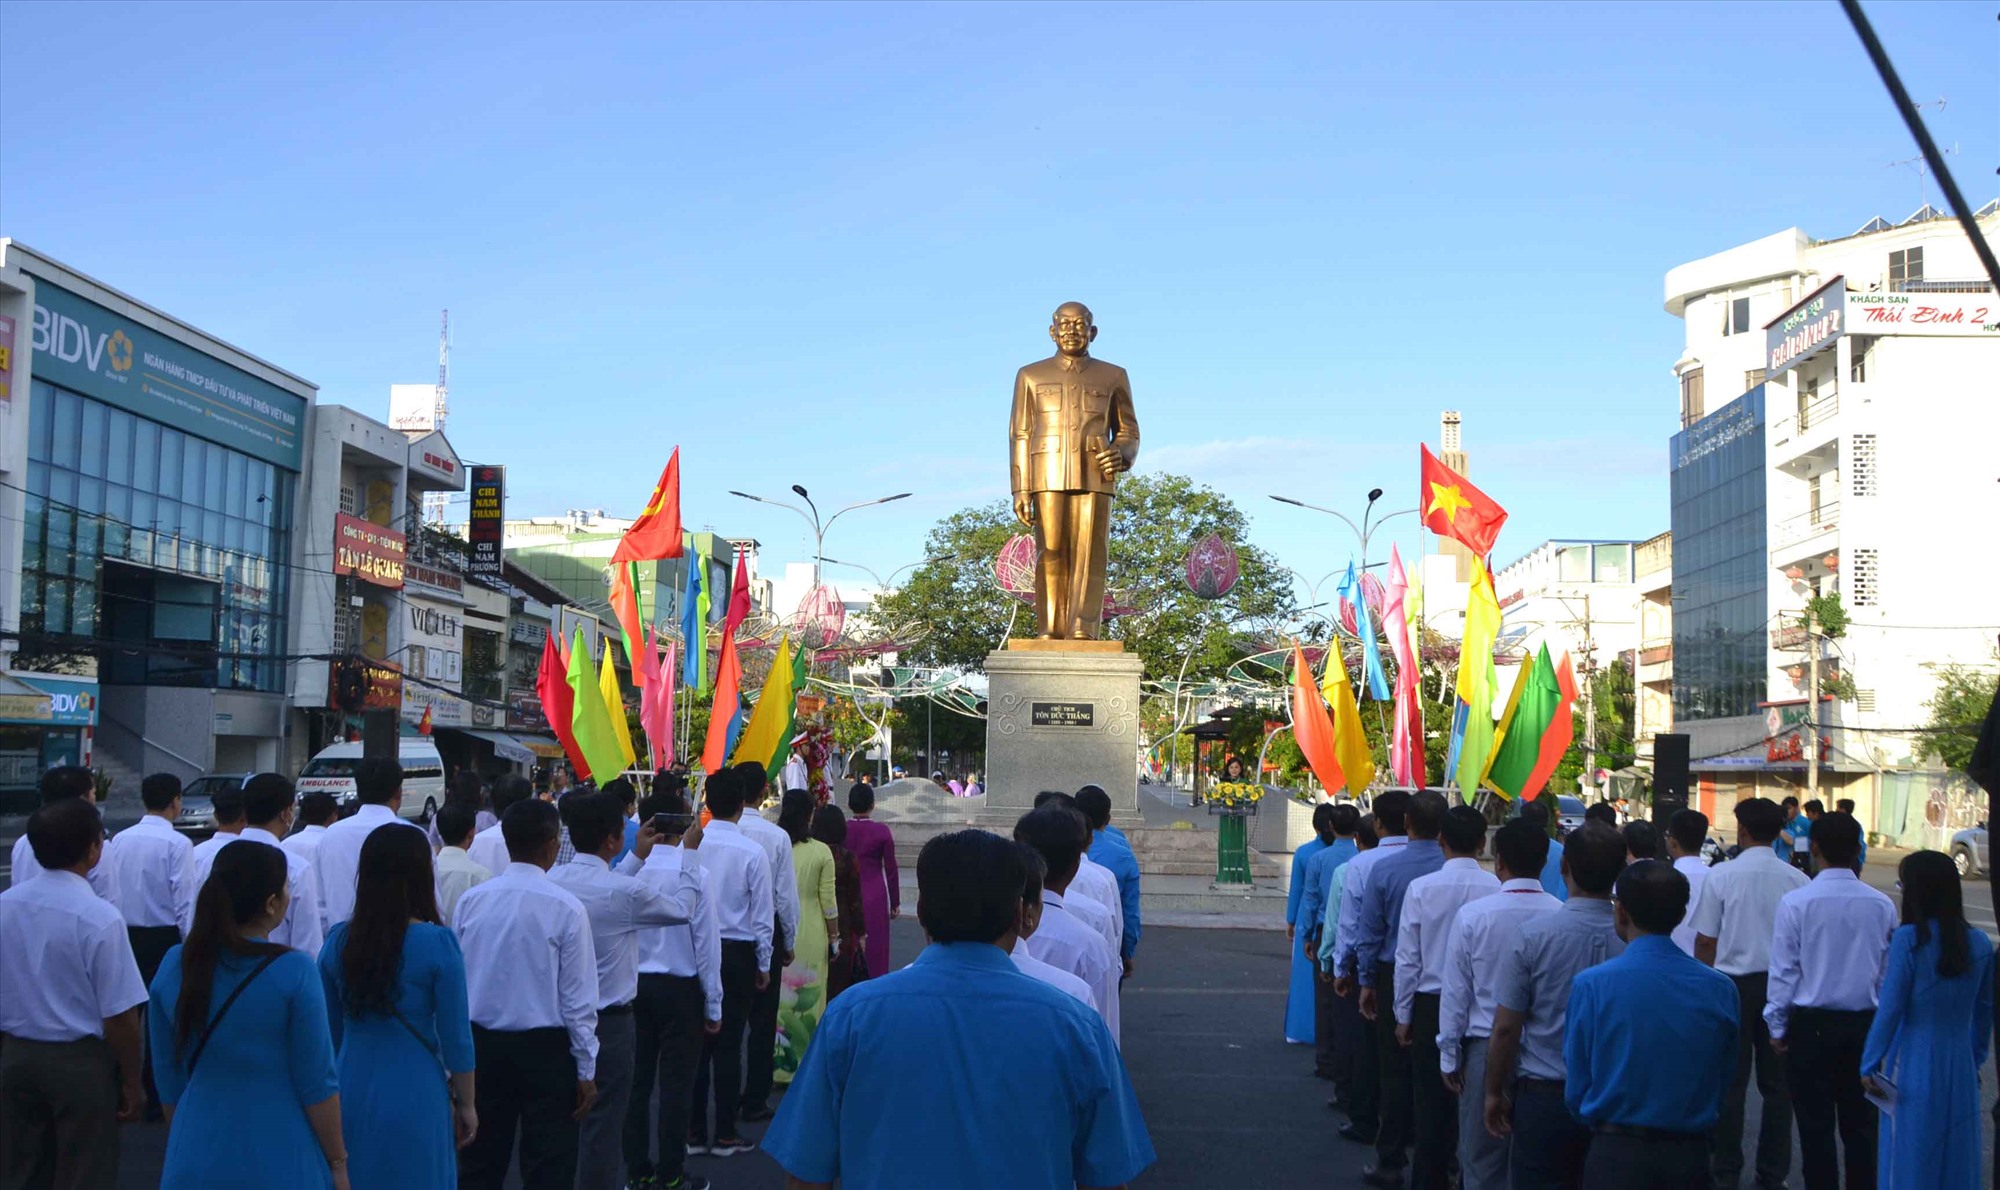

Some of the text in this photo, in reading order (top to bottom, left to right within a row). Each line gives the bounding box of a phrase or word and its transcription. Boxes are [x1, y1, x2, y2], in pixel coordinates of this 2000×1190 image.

[1850, 295, 1884, 303] KHÁCH
[1863, 306, 1988, 323] Thái Bình 2
[32, 303, 109, 372] BIDV
[186, 370, 205, 386] TMCP
[282, 411, 296, 426] NAM
[475, 498, 498, 507] NAM
[343, 524, 358, 539] CÔNG
[475, 552, 495, 561] NAM
[360, 550, 372, 573] LÊ
[372, 557, 404, 580] QUANG
[50, 694, 79, 712] BIDV
[1035, 711, 1049, 719] TÔN
[1051, 711, 1065, 719] ĐỨC
